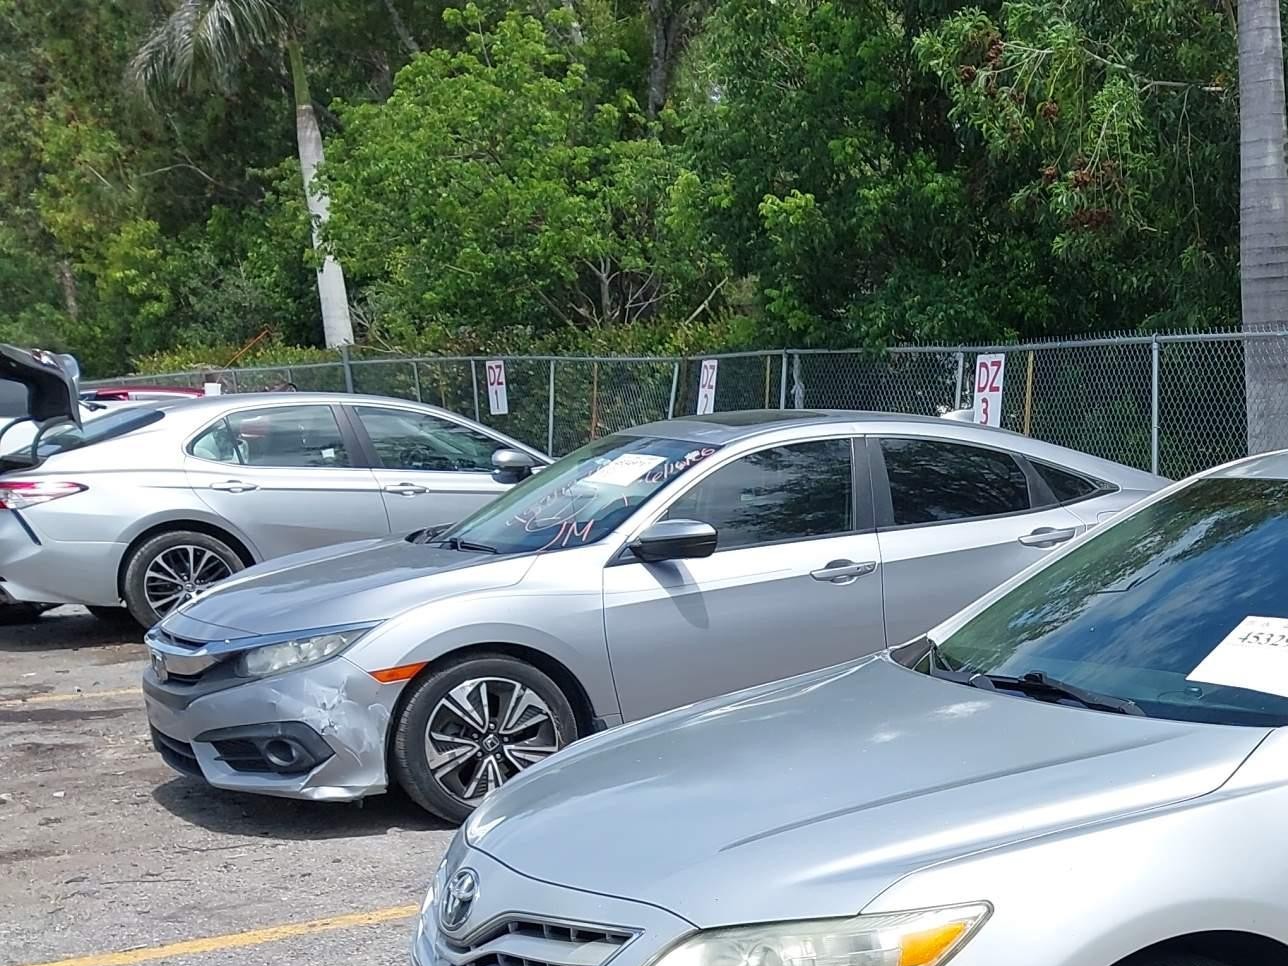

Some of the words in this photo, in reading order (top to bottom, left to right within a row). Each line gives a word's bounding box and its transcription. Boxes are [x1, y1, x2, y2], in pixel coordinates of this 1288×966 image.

[487, 364, 504, 386] DZ
[702, 364, 715, 389] DZ
[977, 360, 1001, 393] DZ
[979, 397, 989, 425] 3
